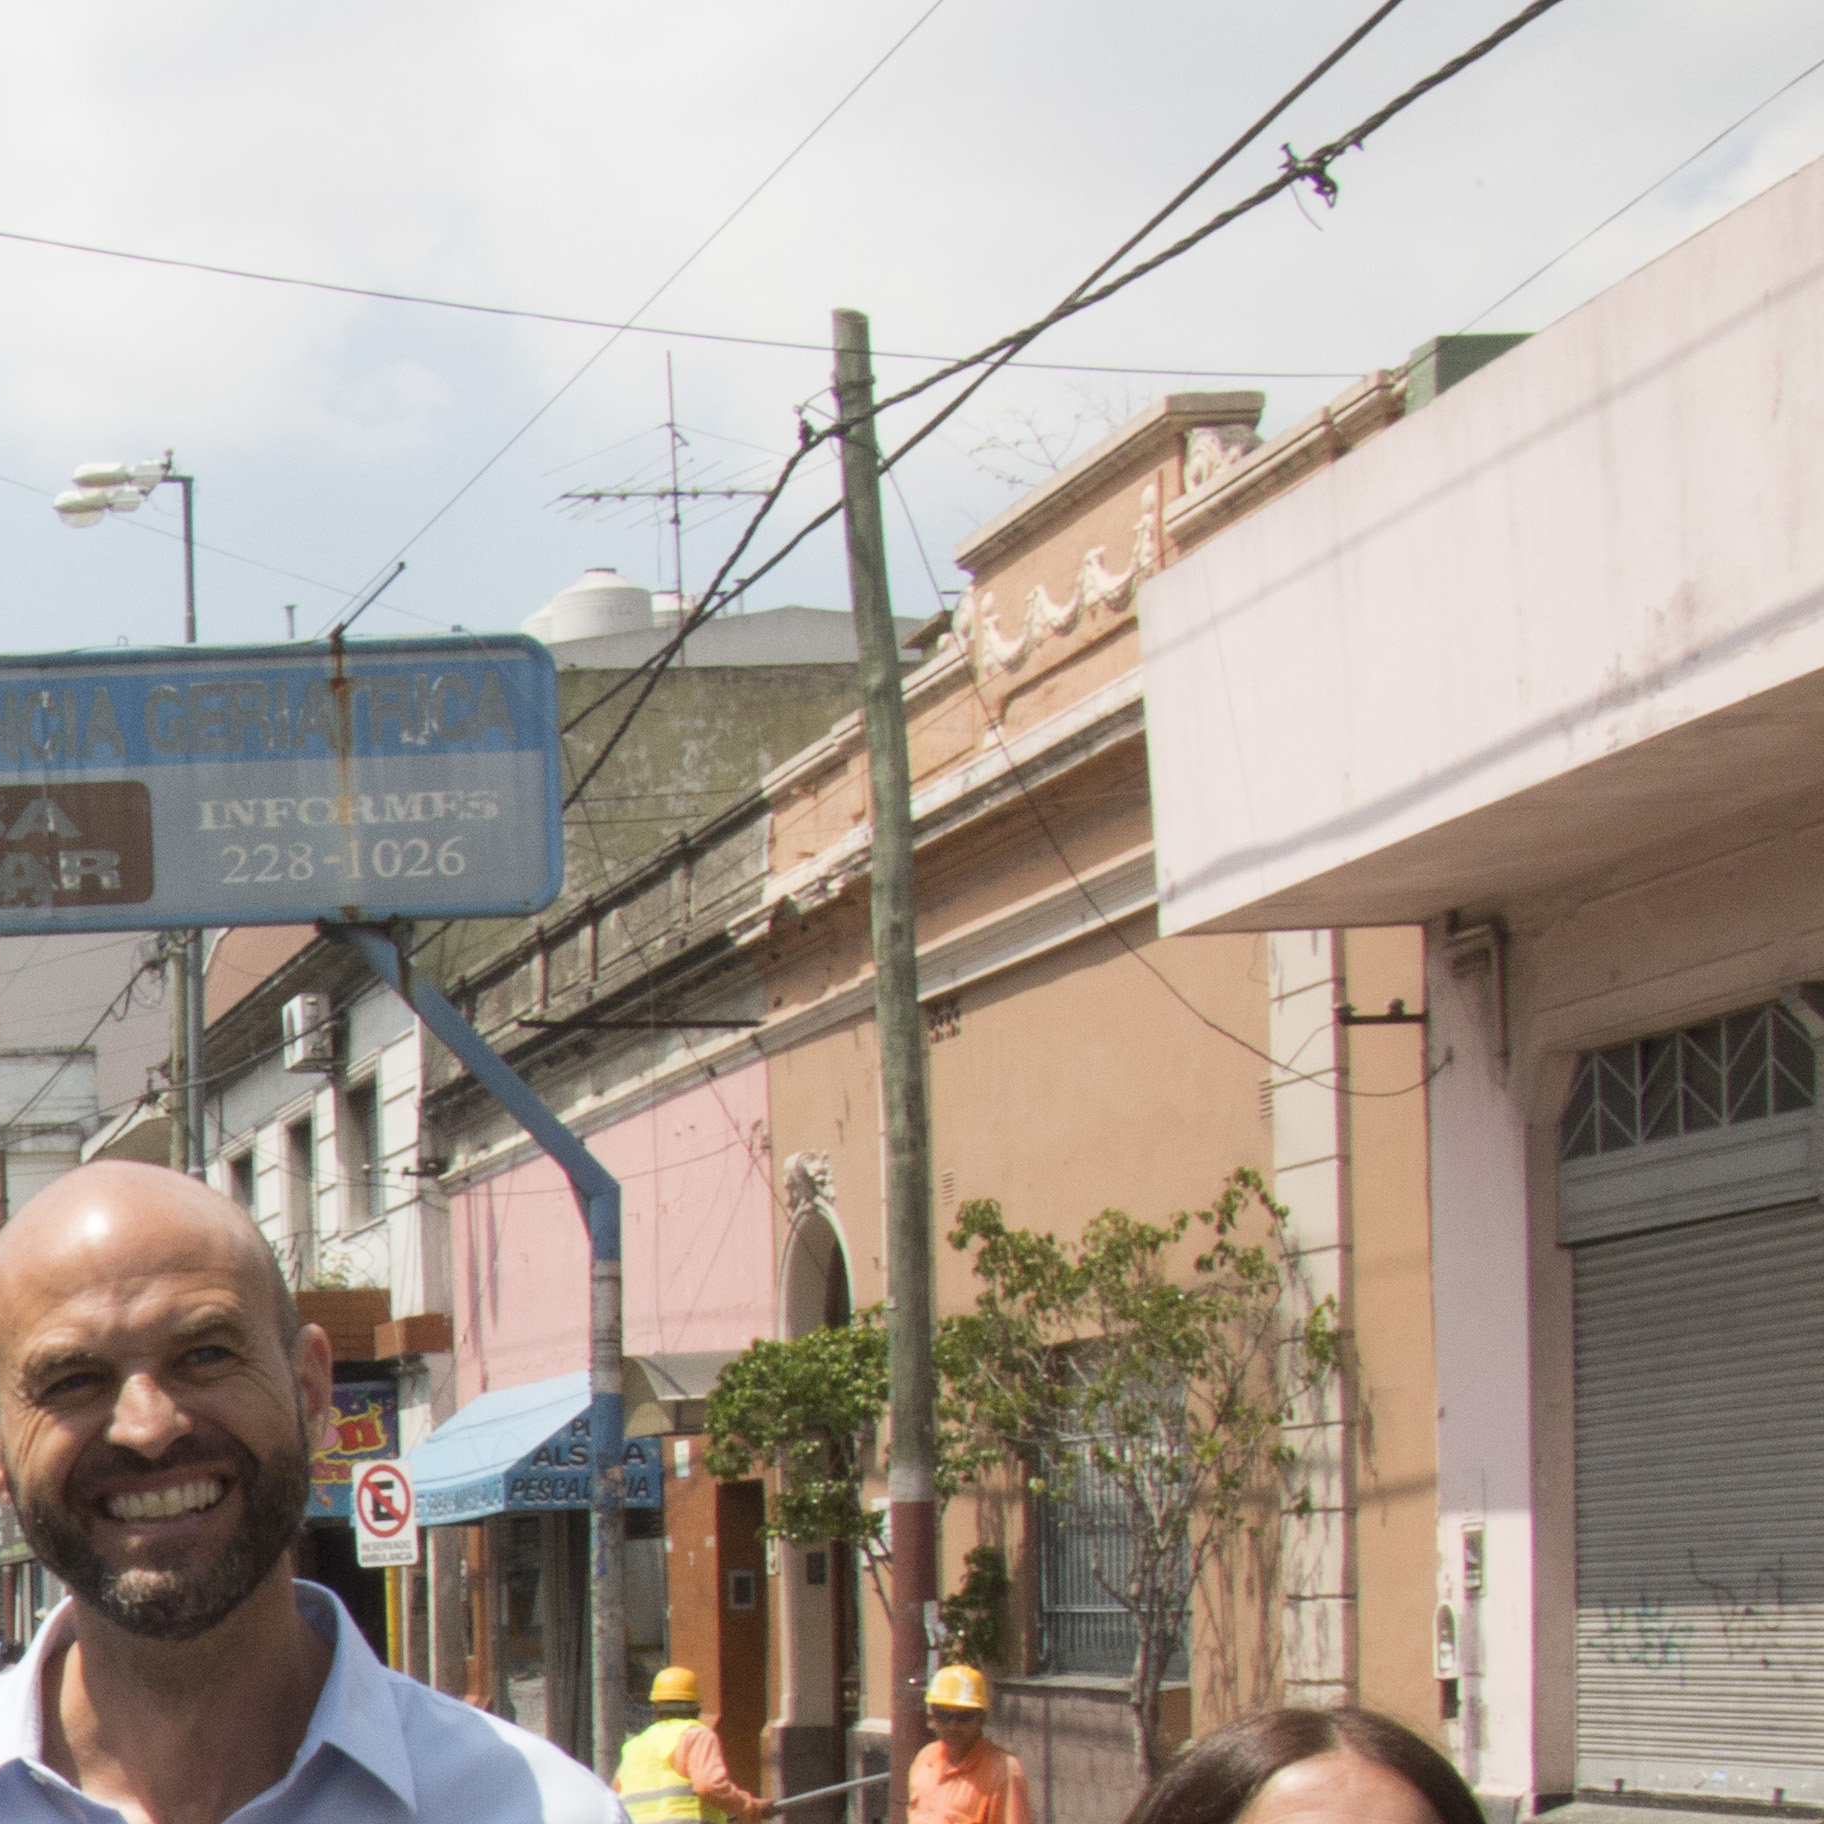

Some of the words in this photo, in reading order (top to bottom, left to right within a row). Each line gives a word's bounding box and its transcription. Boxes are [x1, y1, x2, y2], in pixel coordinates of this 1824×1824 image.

[149, 669, 516, 756] GERIATRICA
[198, 788, 501, 831] INFORMES
[220, 836, 468, 884] 228-1026
[533, 1443, 646, 1467] ALSA
